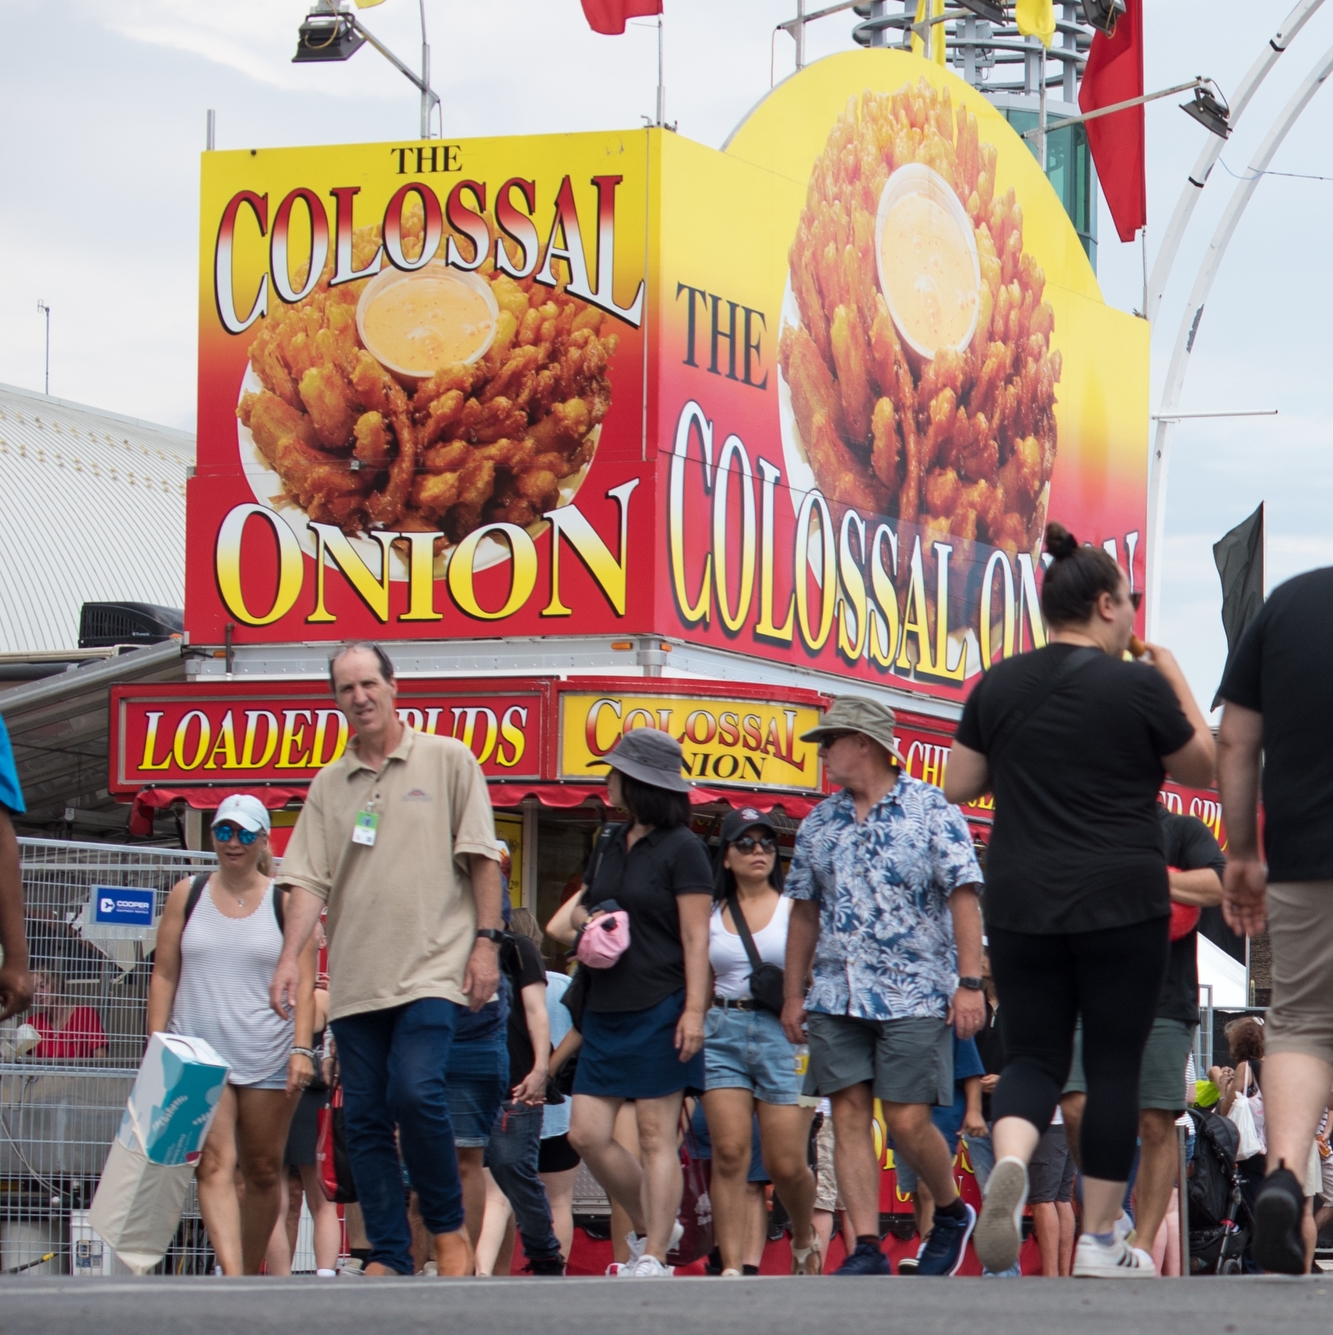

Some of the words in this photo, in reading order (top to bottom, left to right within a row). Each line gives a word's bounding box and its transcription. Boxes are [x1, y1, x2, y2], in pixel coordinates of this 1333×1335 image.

[391, 145, 463, 175] THE
[213, 174, 645, 335] COLOSSAL
[675, 280, 768, 390] THE
[214, 477, 640, 627] ONION
[667, 399, 967, 686] COLOSSAL
[138, 708, 350, 771] LOADED
[681, 753, 767, 780] NION
